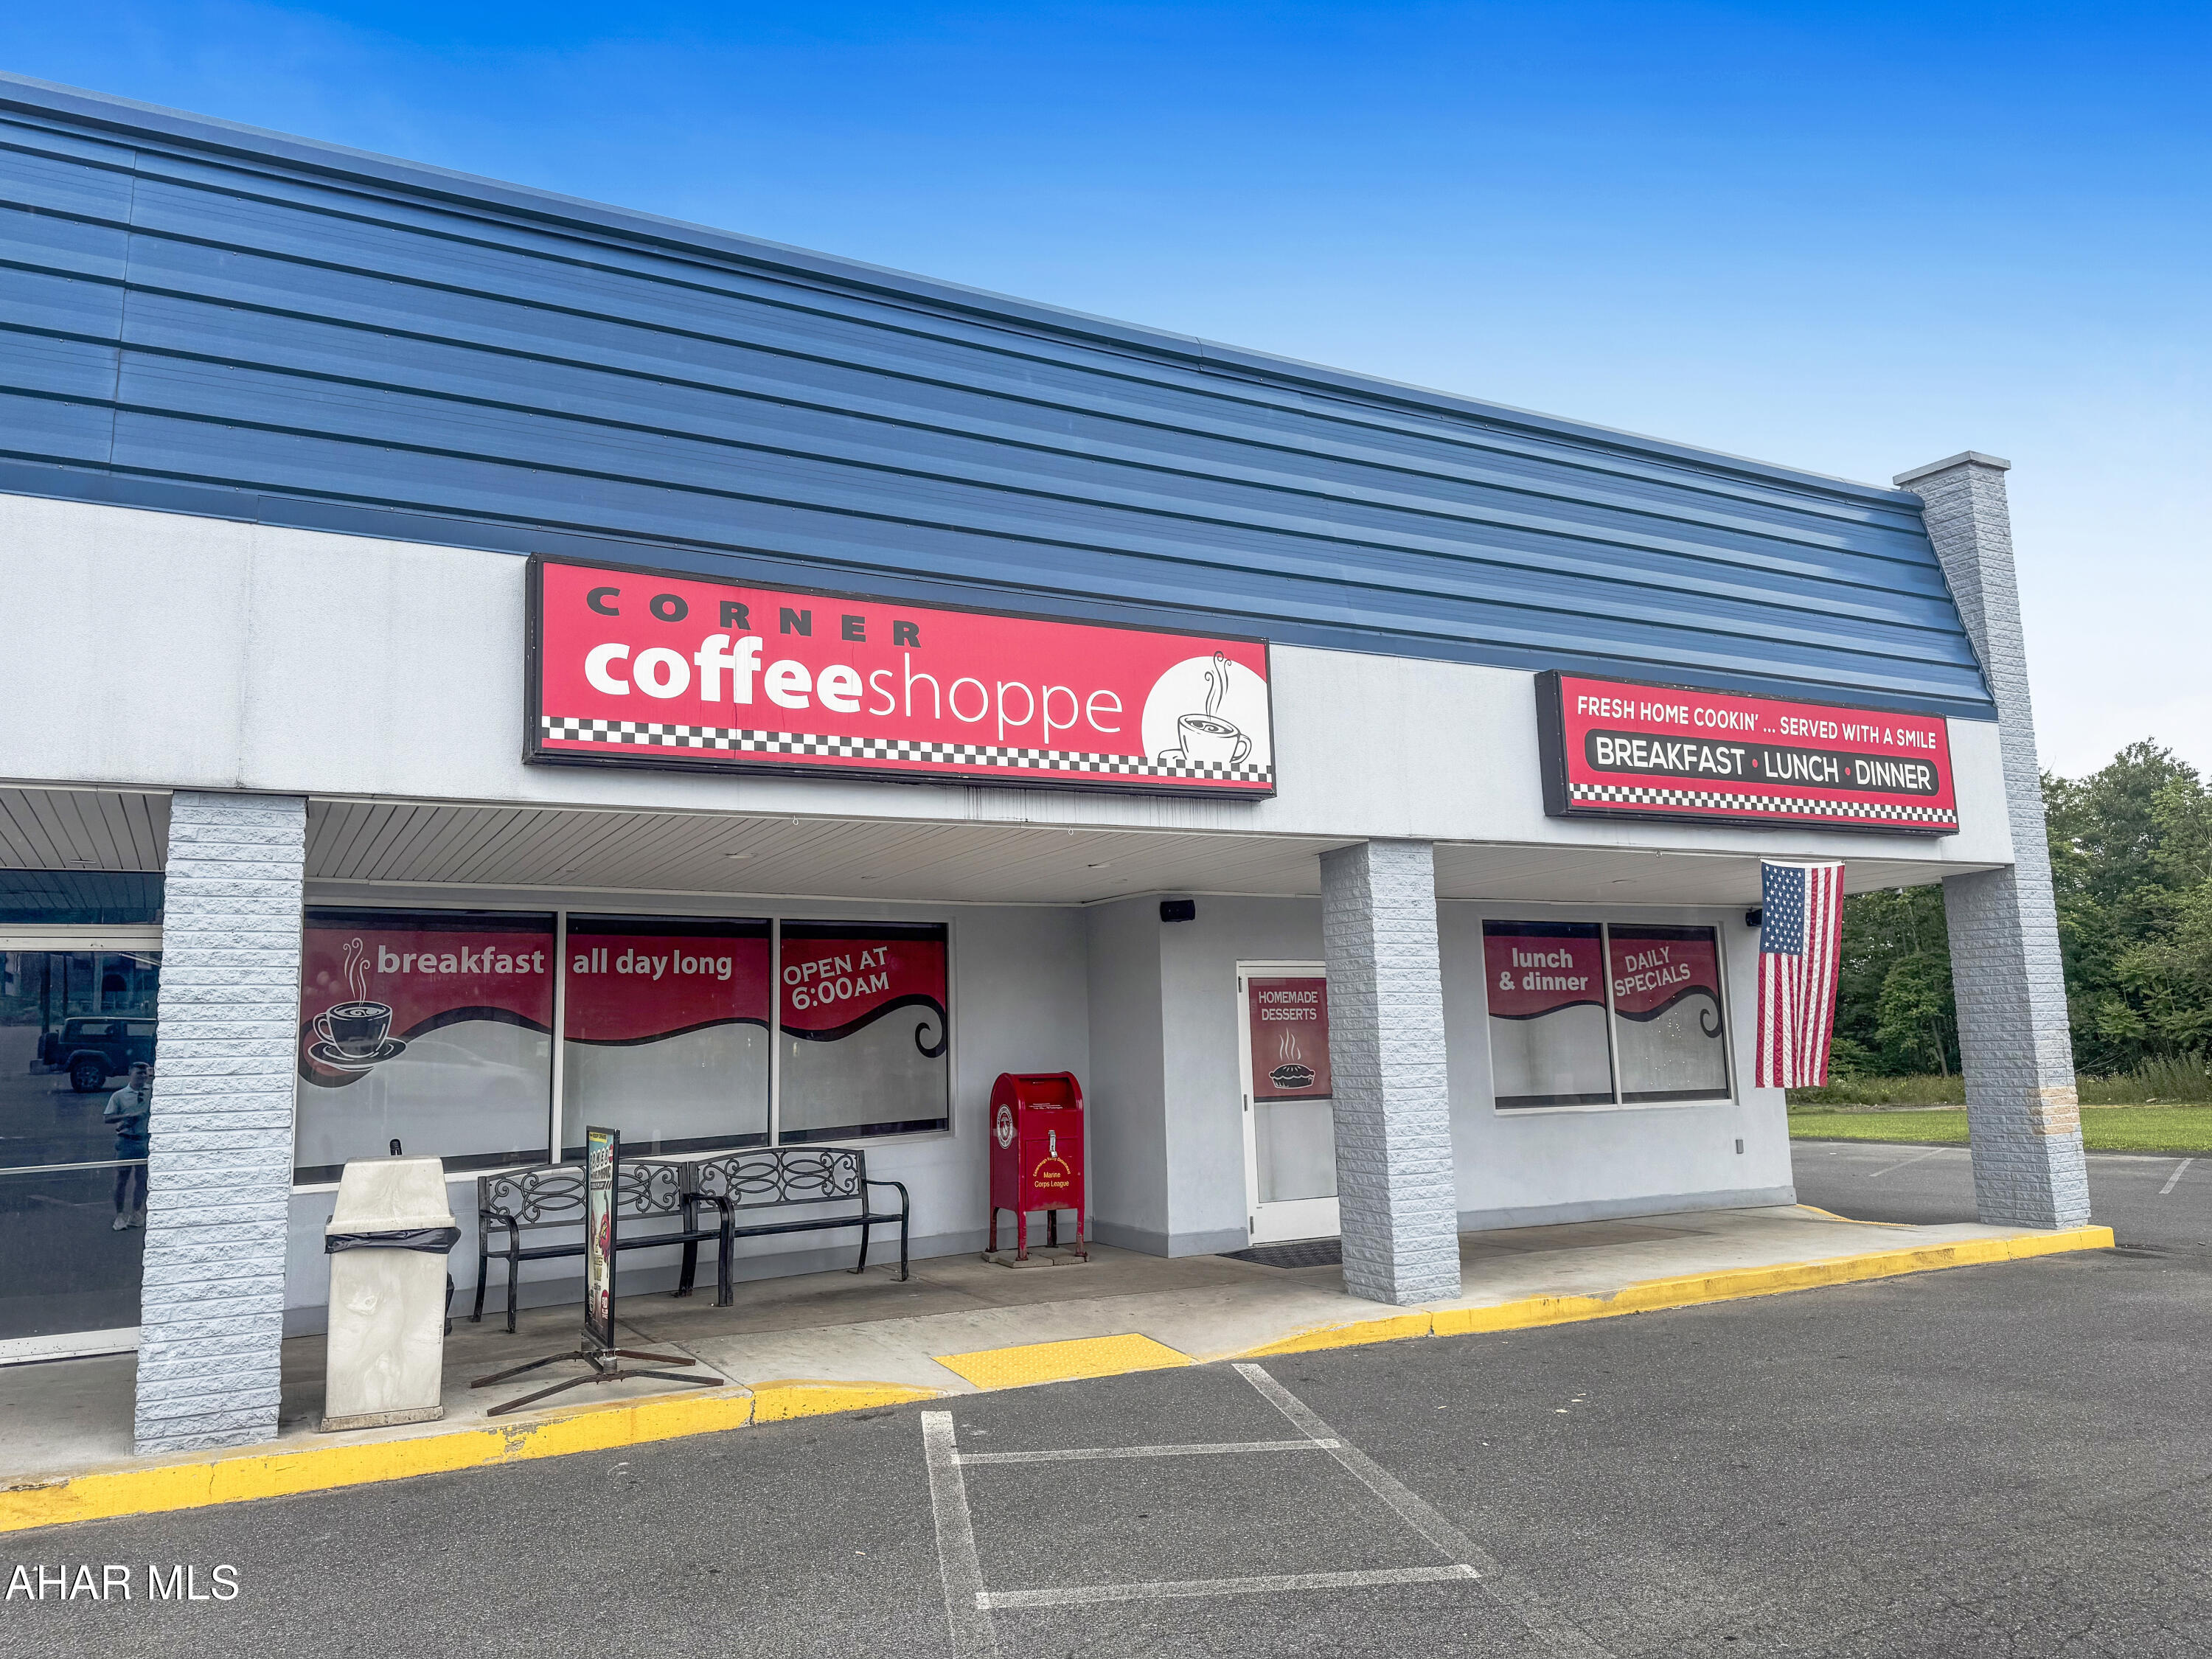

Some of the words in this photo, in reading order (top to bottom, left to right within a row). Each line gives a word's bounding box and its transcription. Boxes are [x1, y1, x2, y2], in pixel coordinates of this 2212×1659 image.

[586, 587, 922, 648] CORNER
[1578, 696, 1635, 720] FRESH
[1641, 702, 1689, 725] HOME
[1780, 716, 1838, 740] SERVED
[1842, 723, 1879, 744] WITH
[1883, 728, 1893, 745] A
[1896, 728, 1936, 749] SMILE
[1596, 737, 1745, 775] BREAKFAST
[1764, 751, 1840, 783] LUNCH
[1855, 759, 1932, 790] DINNER
[378, 945, 545, 974] breakfast
[573, 947, 607, 974] all
[616, 948, 668, 981] day
[673, 949, 732, 981] long
[783, 954, 852, 985] OPEN
[859, 946, 888, 970] AT
[1512, 947, 1573, 968] lunch
[1625, 947, 1670, 973] DAILY
[792, 972, 890, 1009] 6:00AM
[1499, 971, 1515, 991] &
[1522, 972, 1588, 991] dinner
[1615, 963, 1691, 997] SPECIALS
[1259, 991, 1318, 1004] HOMEMADE
[1262, 1008, 1317, 1020] DESSERTS
[1034, 1180, 1050, 1189] Corps
